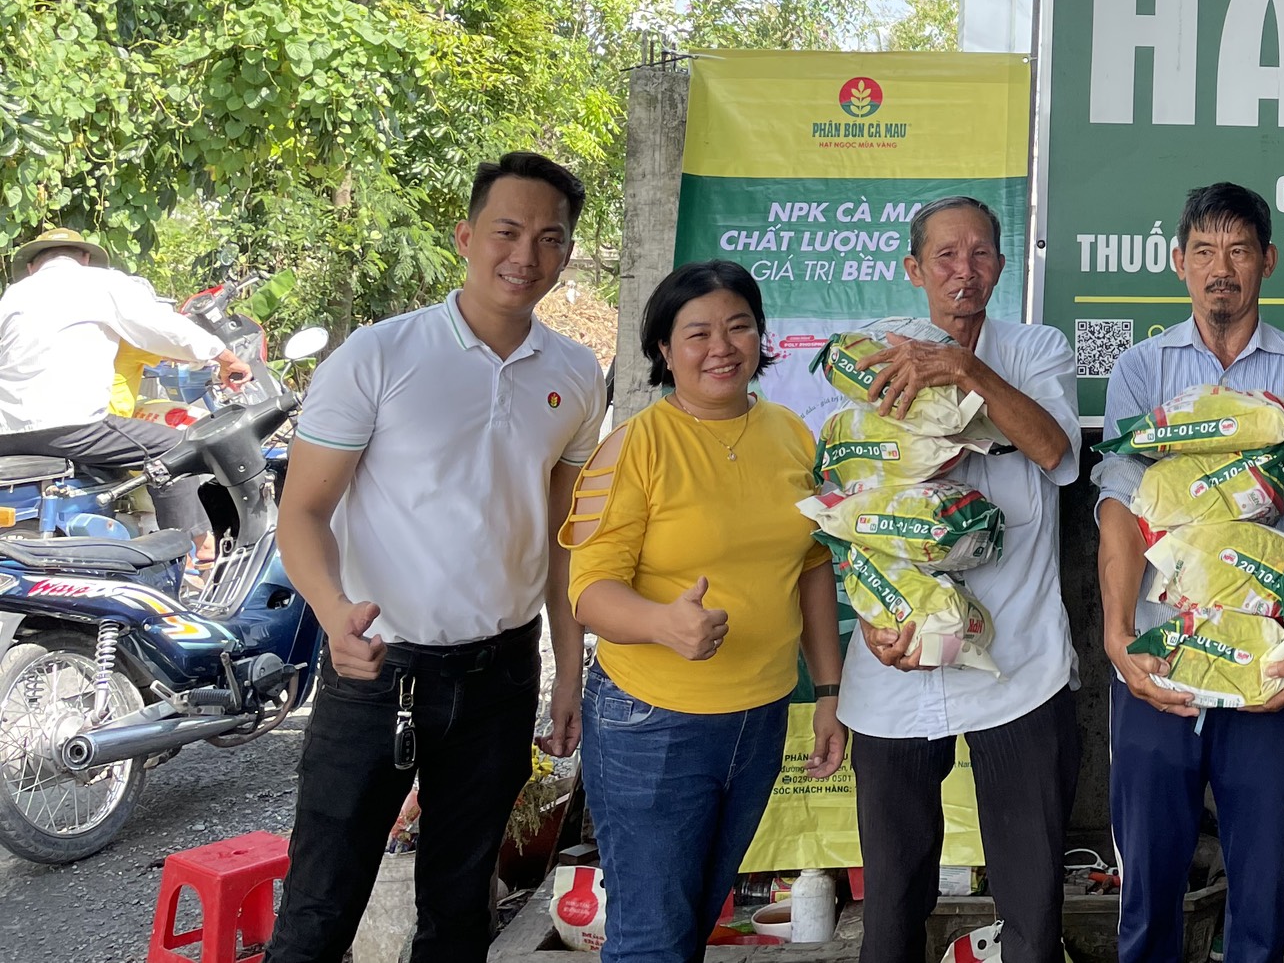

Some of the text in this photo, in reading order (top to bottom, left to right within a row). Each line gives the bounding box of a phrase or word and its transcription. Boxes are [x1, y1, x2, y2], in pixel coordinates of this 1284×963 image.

[812, 120, 907, 138] PHÂN BÓN CÀ MAU
[768, 195, 923, 222] NPK CÀ MA
[719, 223, 900, 257] CHẤT LƯỢNG
[750, 254, 794, 281] GIÁ
[804, 261, 836, 284] TRỊ
[841, 253, 897, 281] BỀN
[1157, 421, 1217, 438] 20-10-10
[853, 559, 895, 603] 20-10-10
[1238, 560, 1280, 588] 20-10-
[784, 753, 809, 762] PHÂN
[773, 784, 852, 795] SÓC KHÁCH HÀNG:
[832, 775, 851, 783] 0501
